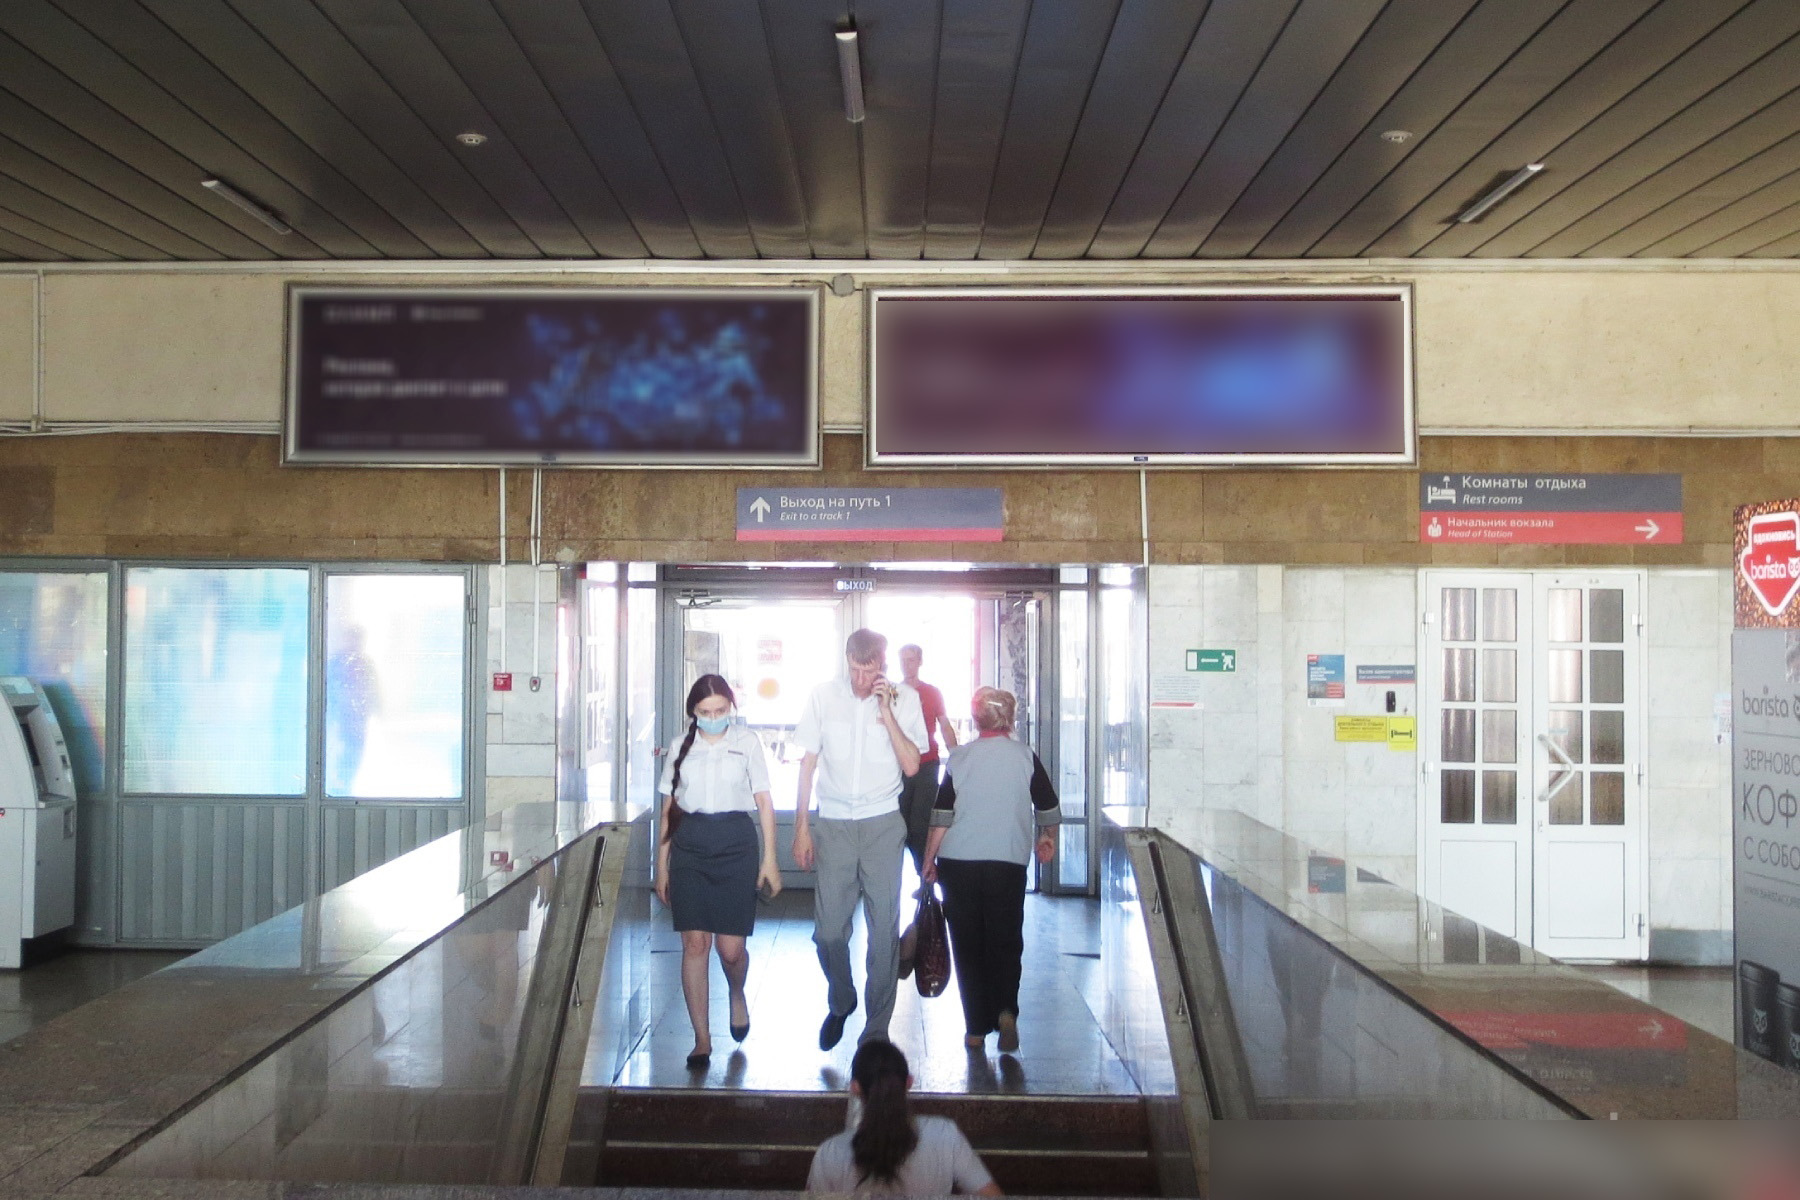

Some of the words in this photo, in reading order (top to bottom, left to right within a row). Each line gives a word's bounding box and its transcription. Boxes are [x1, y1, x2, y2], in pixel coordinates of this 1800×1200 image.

[1462, 476, 1528, 489] Комнаты
[1535, 478, 1587, 491] отдыха
[780, 496, 825, 509] Выход
[829, 498, 845, 507] на
[849, 497, 881, 510] путь
[885, 495, 891, 507] 1
[1462, 494, 1486, 504] Rest
[1488, 496, 1523, 504] rooms
[780, 512, 797, 520] Exit
[799, 512, 809, 520] to
[819, 512, 843, 520] track
[846, 512, 851, 520] 1
[1447, 517, 1507, 527] Начальник
[1510, 518, 1554, 528] вокзала
[1448, 530, 1470, 538] Head
[1472, 530, 1481, 538] of
[1483, 530, 1513, 538] Station
[1750, 554, 1787, 579] barista
[1742, 684, 1789, 717] barista
[1743, 781, 1798, 828] КОФ
[1743, 836, 1754, 860] С
[1758, 839, 1800, 871] СОБО
